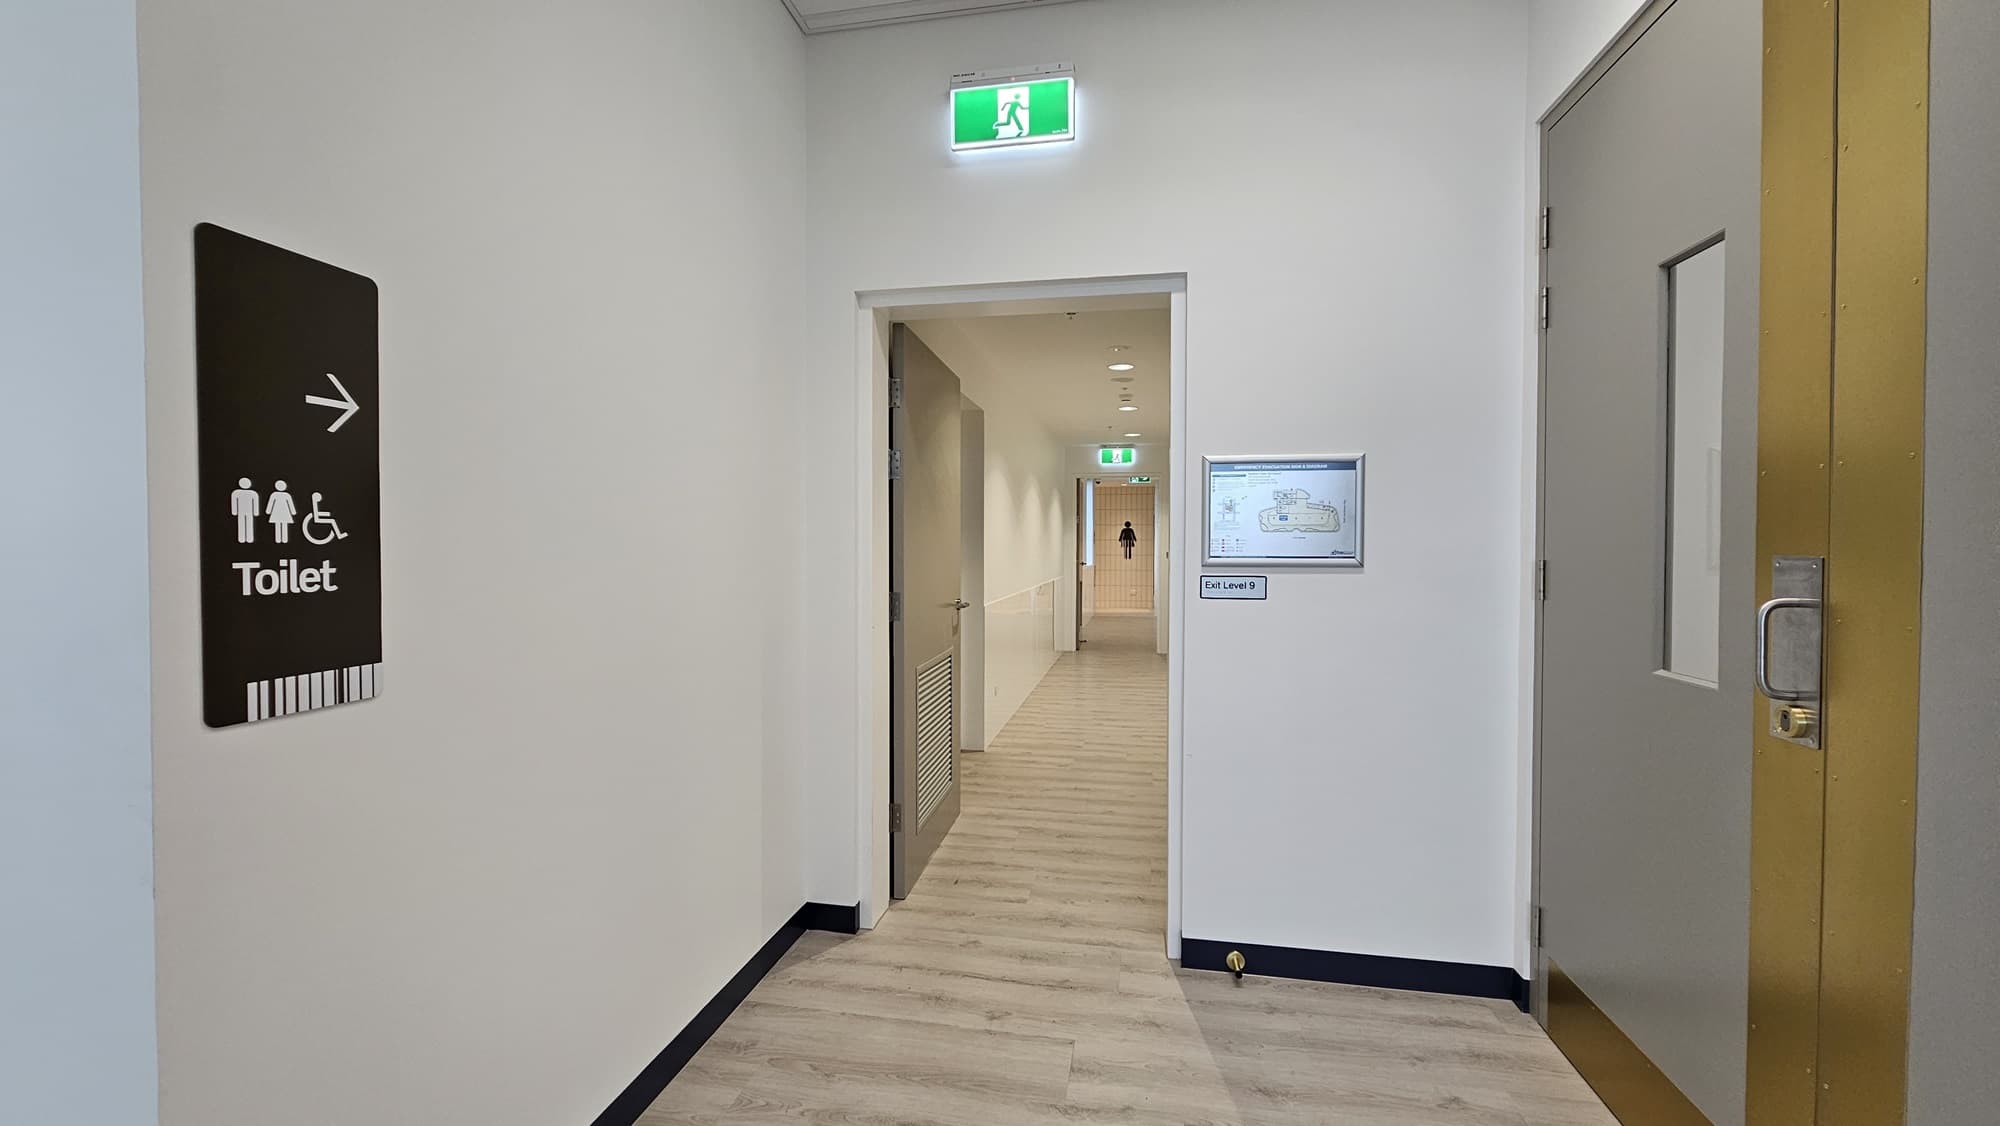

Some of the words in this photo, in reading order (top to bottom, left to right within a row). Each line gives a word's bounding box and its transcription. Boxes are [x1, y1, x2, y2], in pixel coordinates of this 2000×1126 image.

[232, 559, 338, 595] Toilet
[1205, 581, 1221, 589] Exit
[1223, 581, 1247, 590] Level
[1249, 581, 1256, 590] 9
